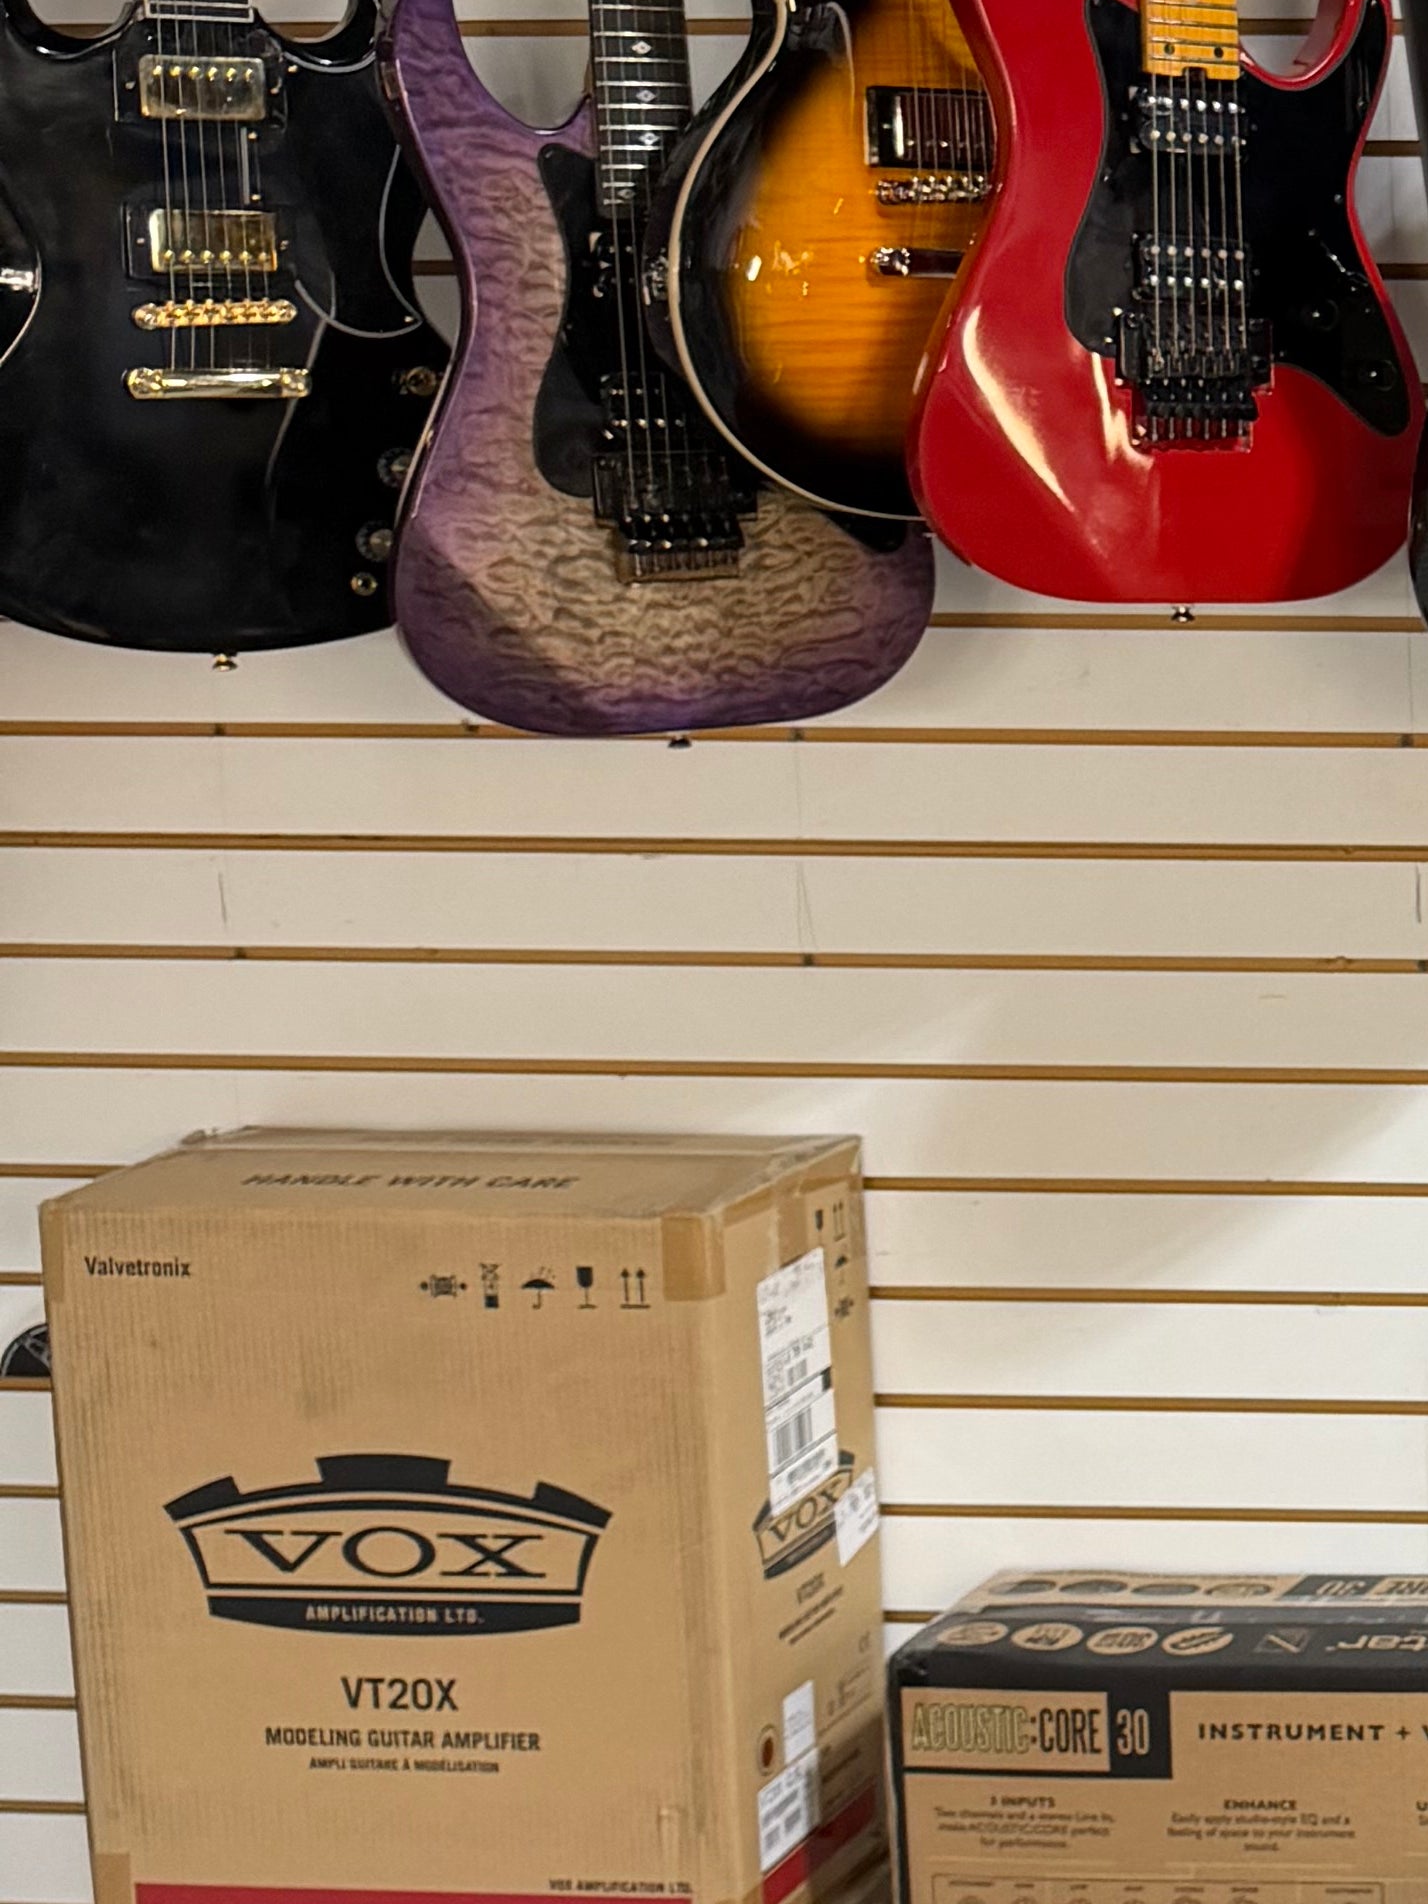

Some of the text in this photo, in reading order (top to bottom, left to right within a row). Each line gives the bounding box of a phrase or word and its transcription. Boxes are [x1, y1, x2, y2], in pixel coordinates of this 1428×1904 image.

[241, 1173, 580, 1190] HANDLE WITH CARE
[84, 1256, 192, 1278] Valvetronix
[223, 1526, 547, 1579] VOX
[305, 1605, 438, 1624] AMPLIFICATION
[340, 1675, 460, 1712] VT20X
[265, 1727, 541, 1752] MODELING GUITAR AMPLIFIER
[1116, 1707, 1151, 1757] 30
[1198, 1722, 1384, 1742] INSTRUMENT
[1223, 1799, 1298, 1812] ENHANCE
[576, 1880, 666, 1894] AMPLIFICATION
